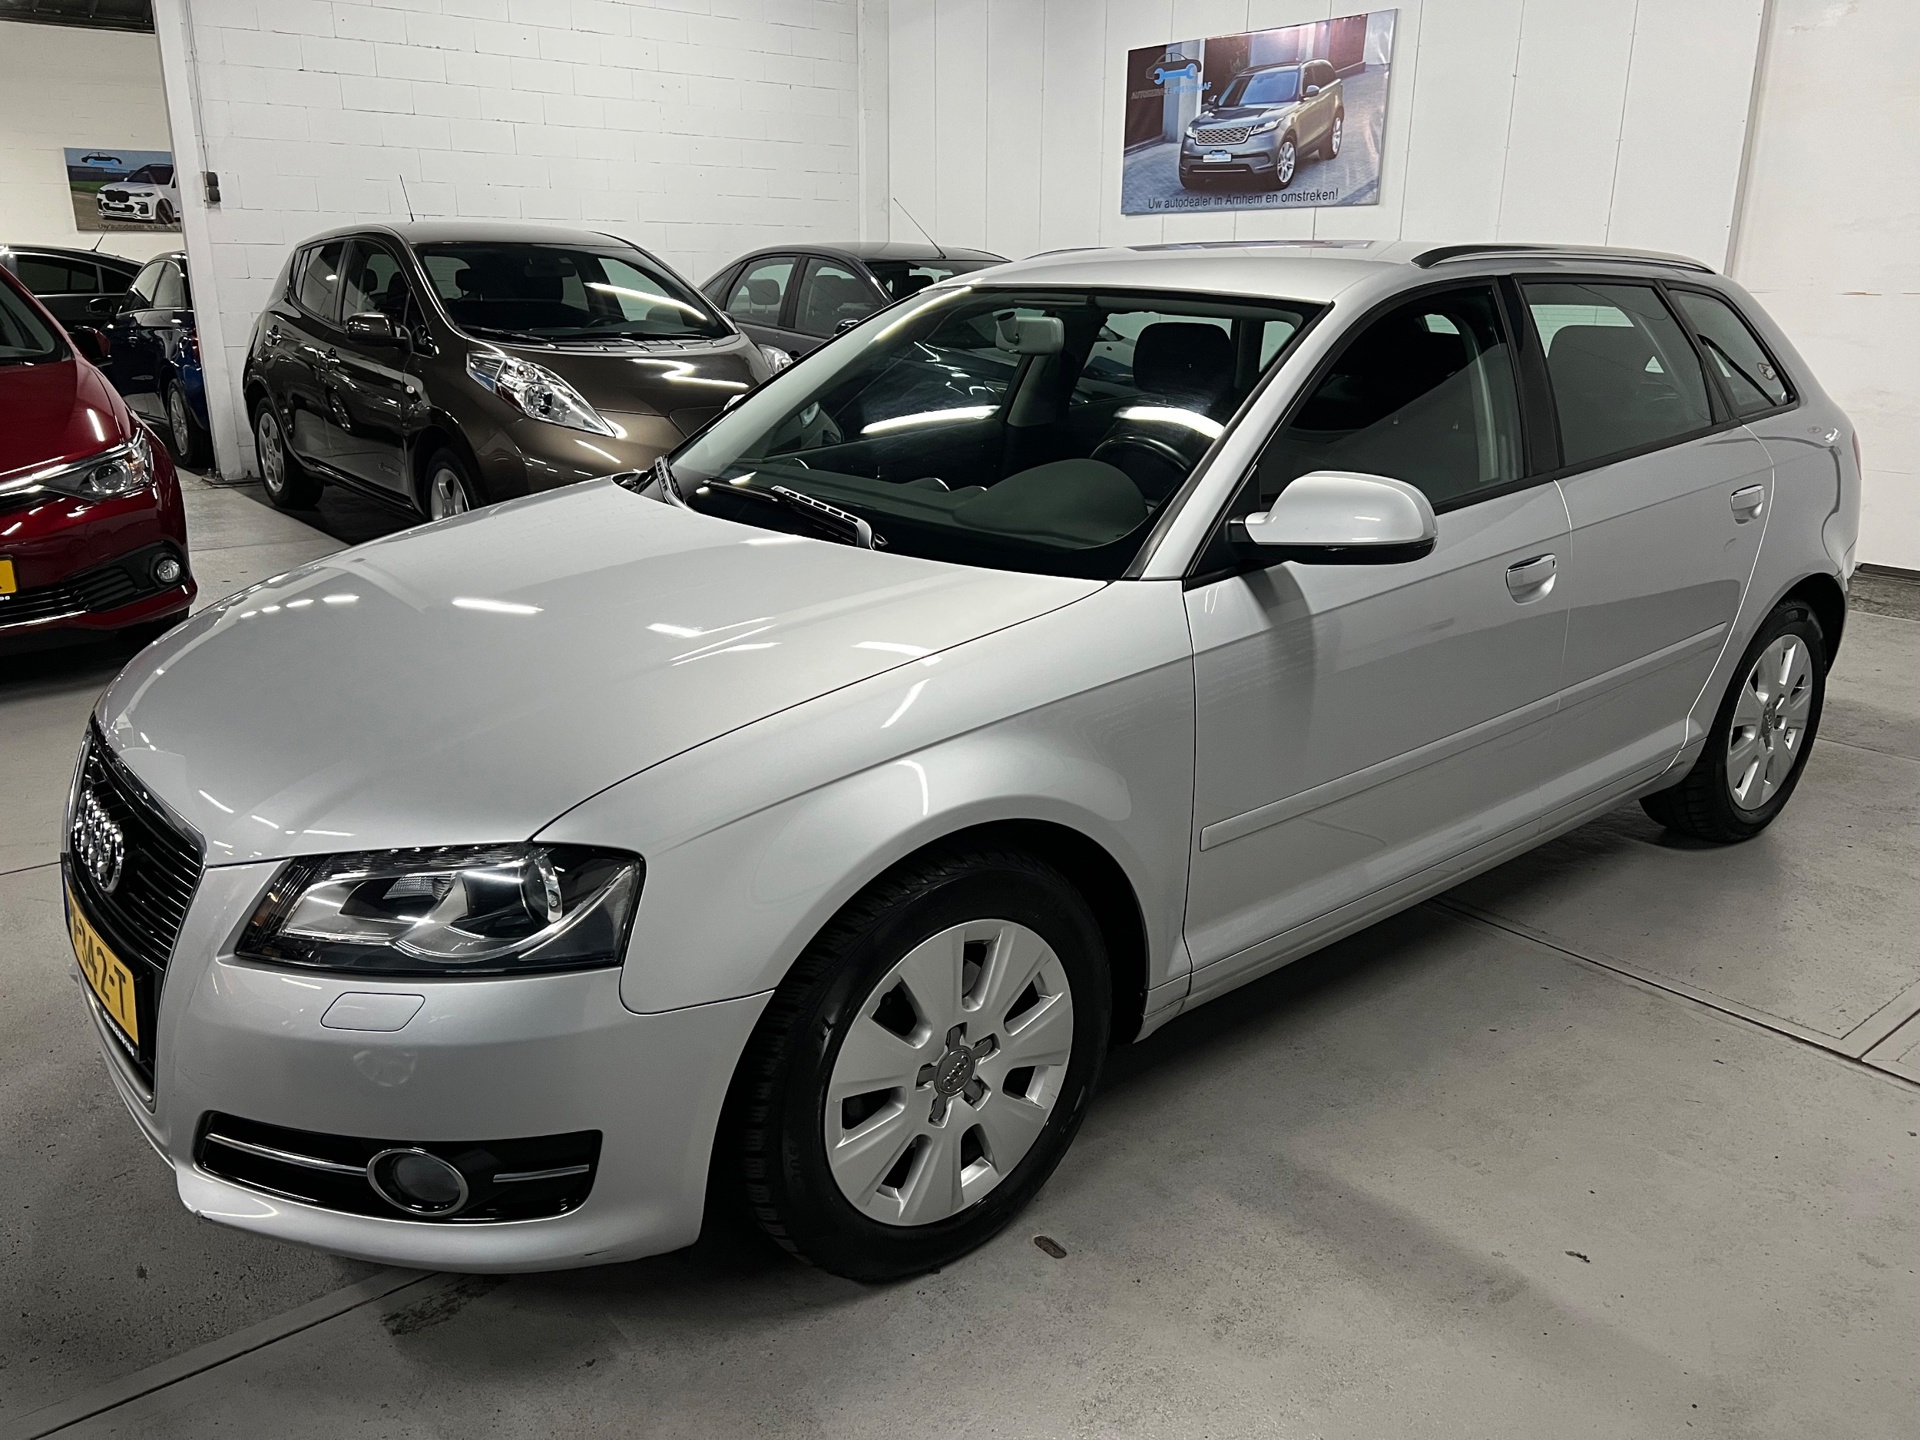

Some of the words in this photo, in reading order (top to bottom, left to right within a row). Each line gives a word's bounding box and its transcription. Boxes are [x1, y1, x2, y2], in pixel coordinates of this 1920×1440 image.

[1147, 197, 1162, 209] Uw
[1164, 195, 1211, 208] autodealer
[1214, 195, 1223, 206] in
[1225, 193, 1263, 205] Arnhem
[1266, 193, 1278, 203] en
[1281, 189, 1339, 203] omstreken!
